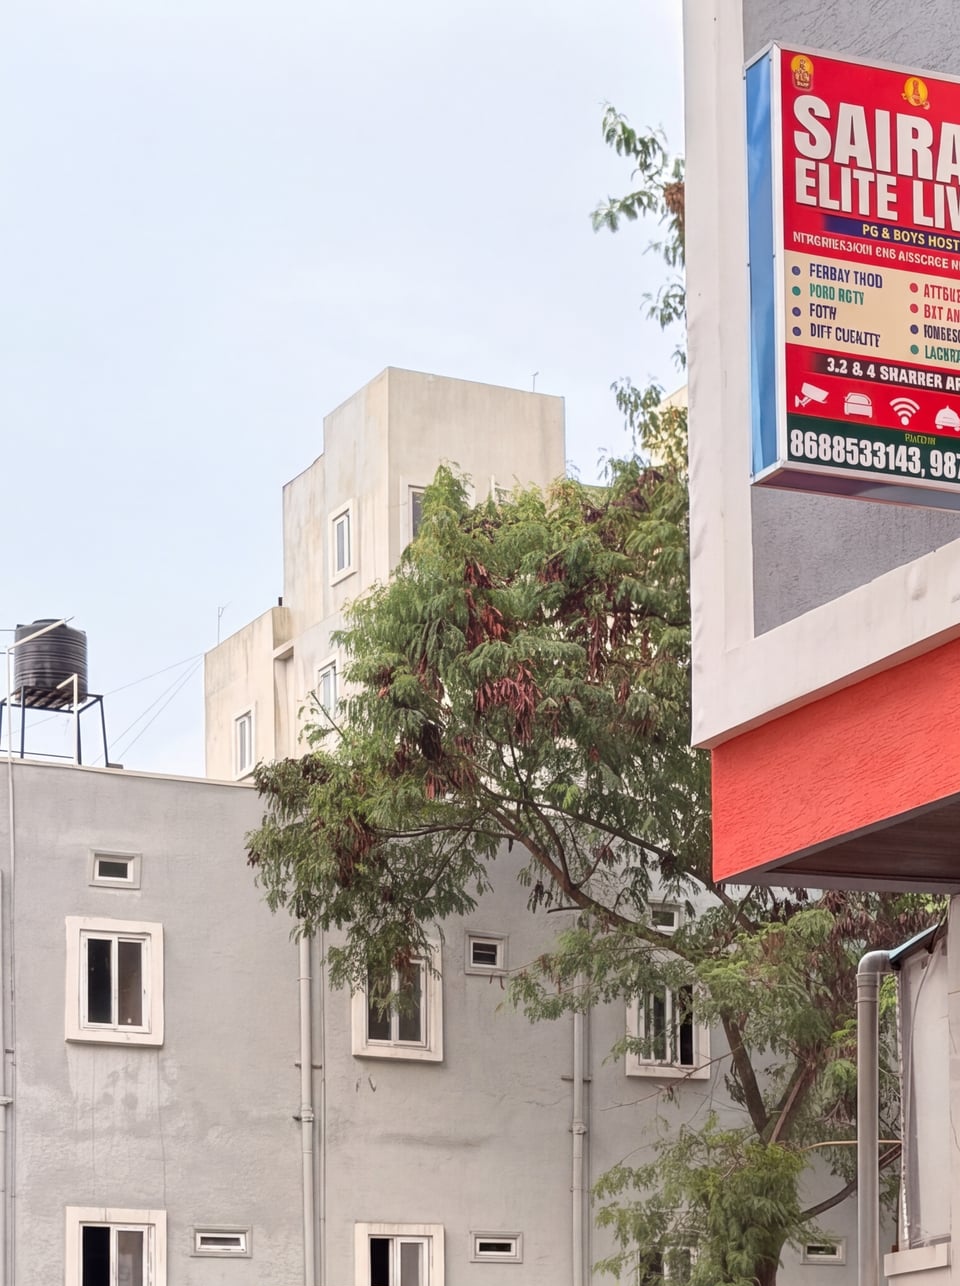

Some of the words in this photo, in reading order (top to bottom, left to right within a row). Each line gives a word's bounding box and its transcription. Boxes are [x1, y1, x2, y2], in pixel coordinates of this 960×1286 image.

[795, 157, 898, 221] ELITE
[862, 224, 879, 238] PG
[881, 227, 891, 240] &
[893, 229, 925, 246] BOYS
[866, 363, 876, 379] 4
